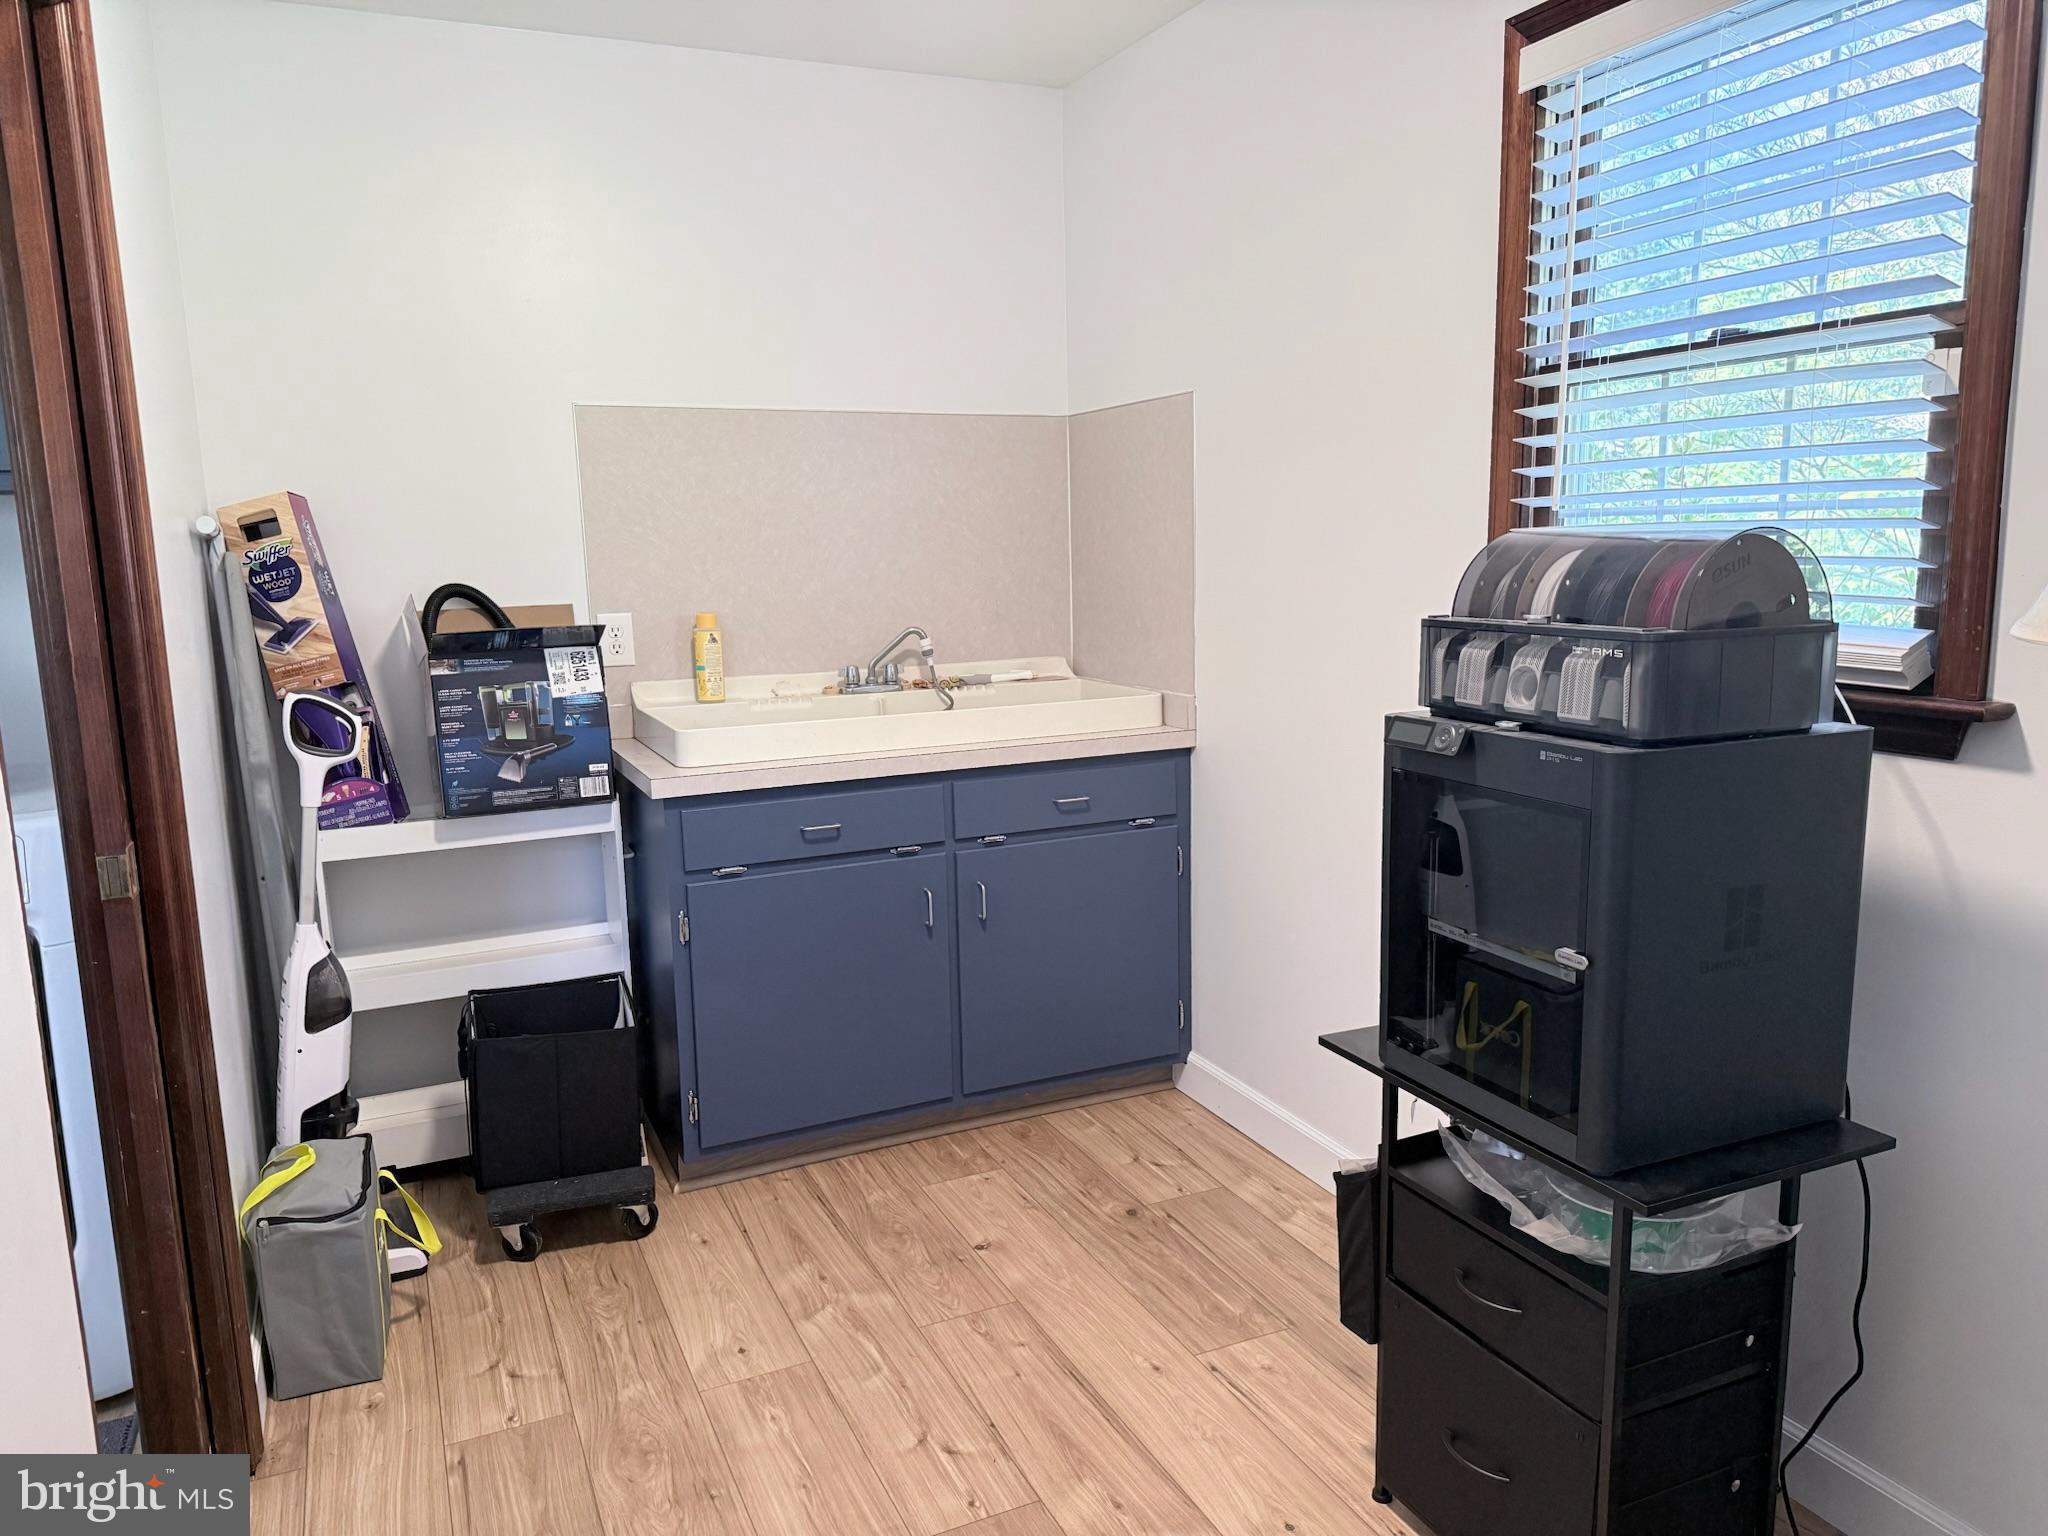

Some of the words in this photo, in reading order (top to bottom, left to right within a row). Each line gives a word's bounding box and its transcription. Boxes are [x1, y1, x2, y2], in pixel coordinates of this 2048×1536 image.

[241, 543, 293, 566] Swiffer
[251, 566, 296, 584] WETJET
[1591, 647, 1624, 658] AMS
